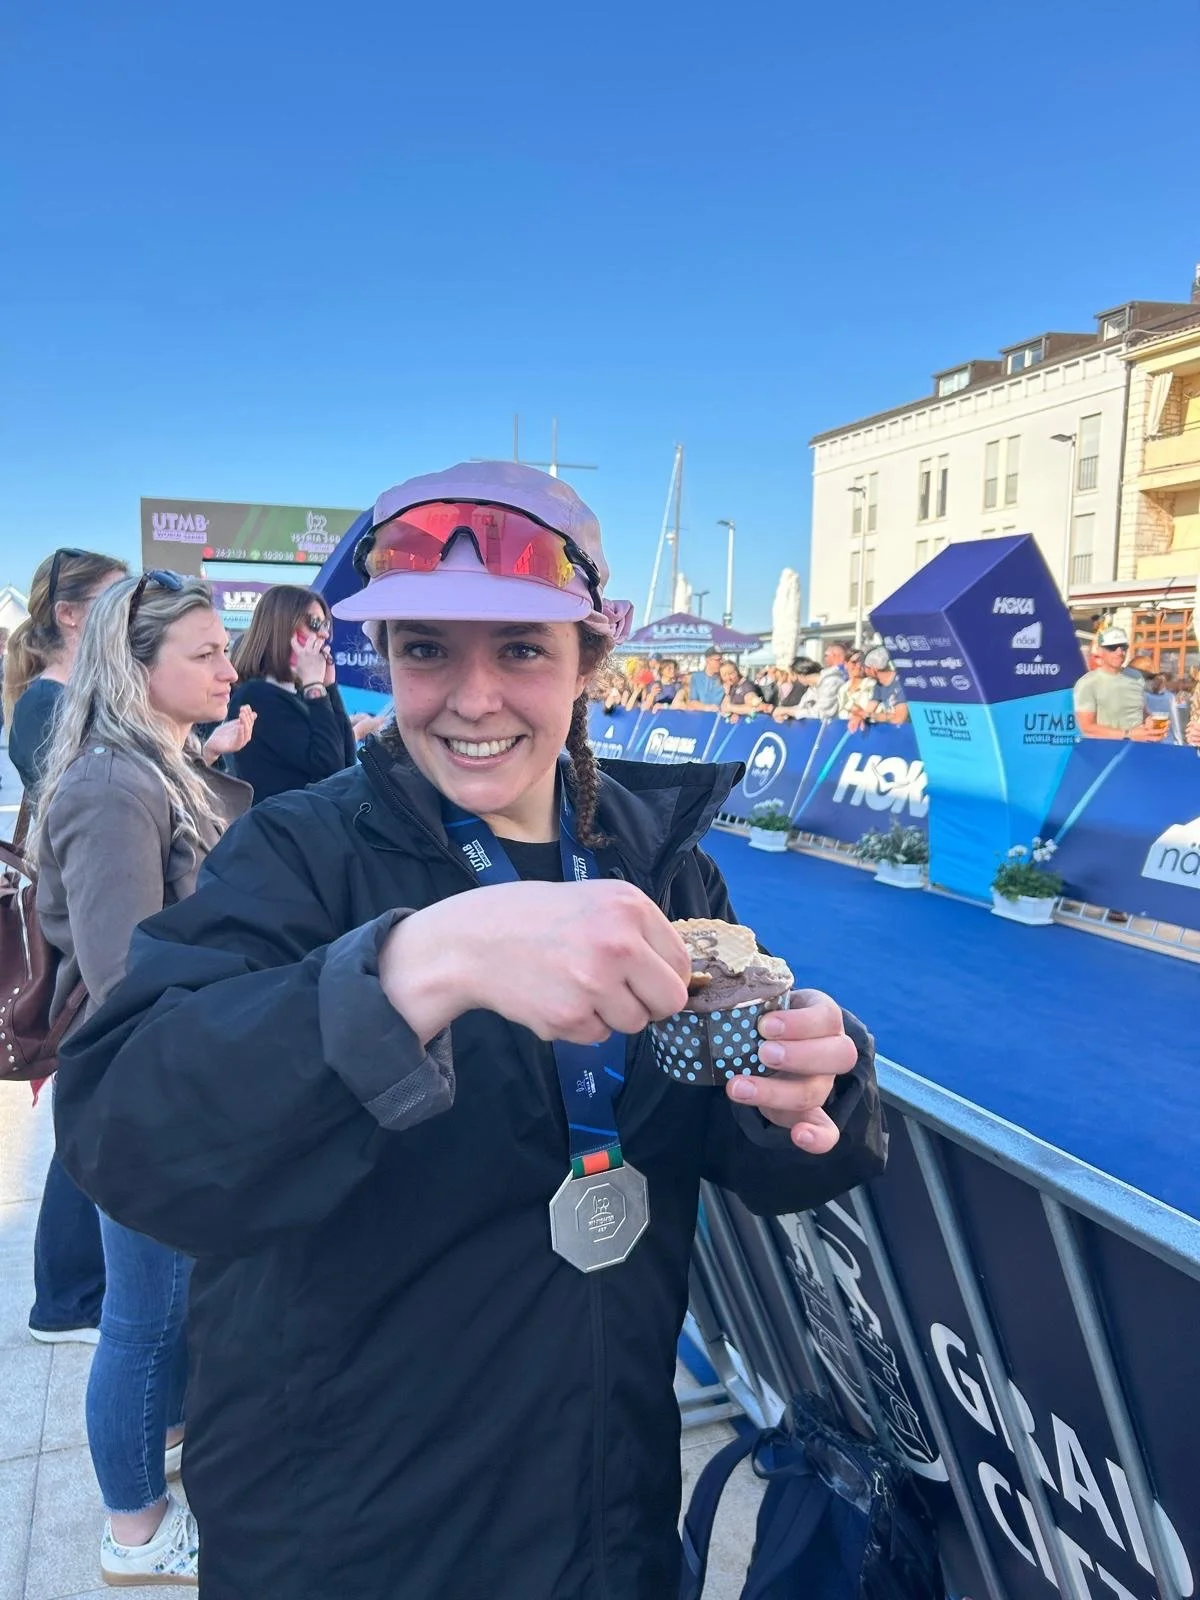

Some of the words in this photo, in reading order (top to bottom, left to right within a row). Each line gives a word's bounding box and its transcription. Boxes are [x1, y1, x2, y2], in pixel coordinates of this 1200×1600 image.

[152, 512, 207, 531] UTMB
[992, 597, 1035, 615] HOKA
[653, 623, 712, 635] UTMB
[335, 651, 378, 667] SUUN
[1015, 663, 1060, 675] SUUNTO
[924, 709, 968, 727] UTMB
[1024, 712, 1076, 731] UTMB
[462, 843, 485, 872] UTMB
[577, 856, 589, 880] UTM
